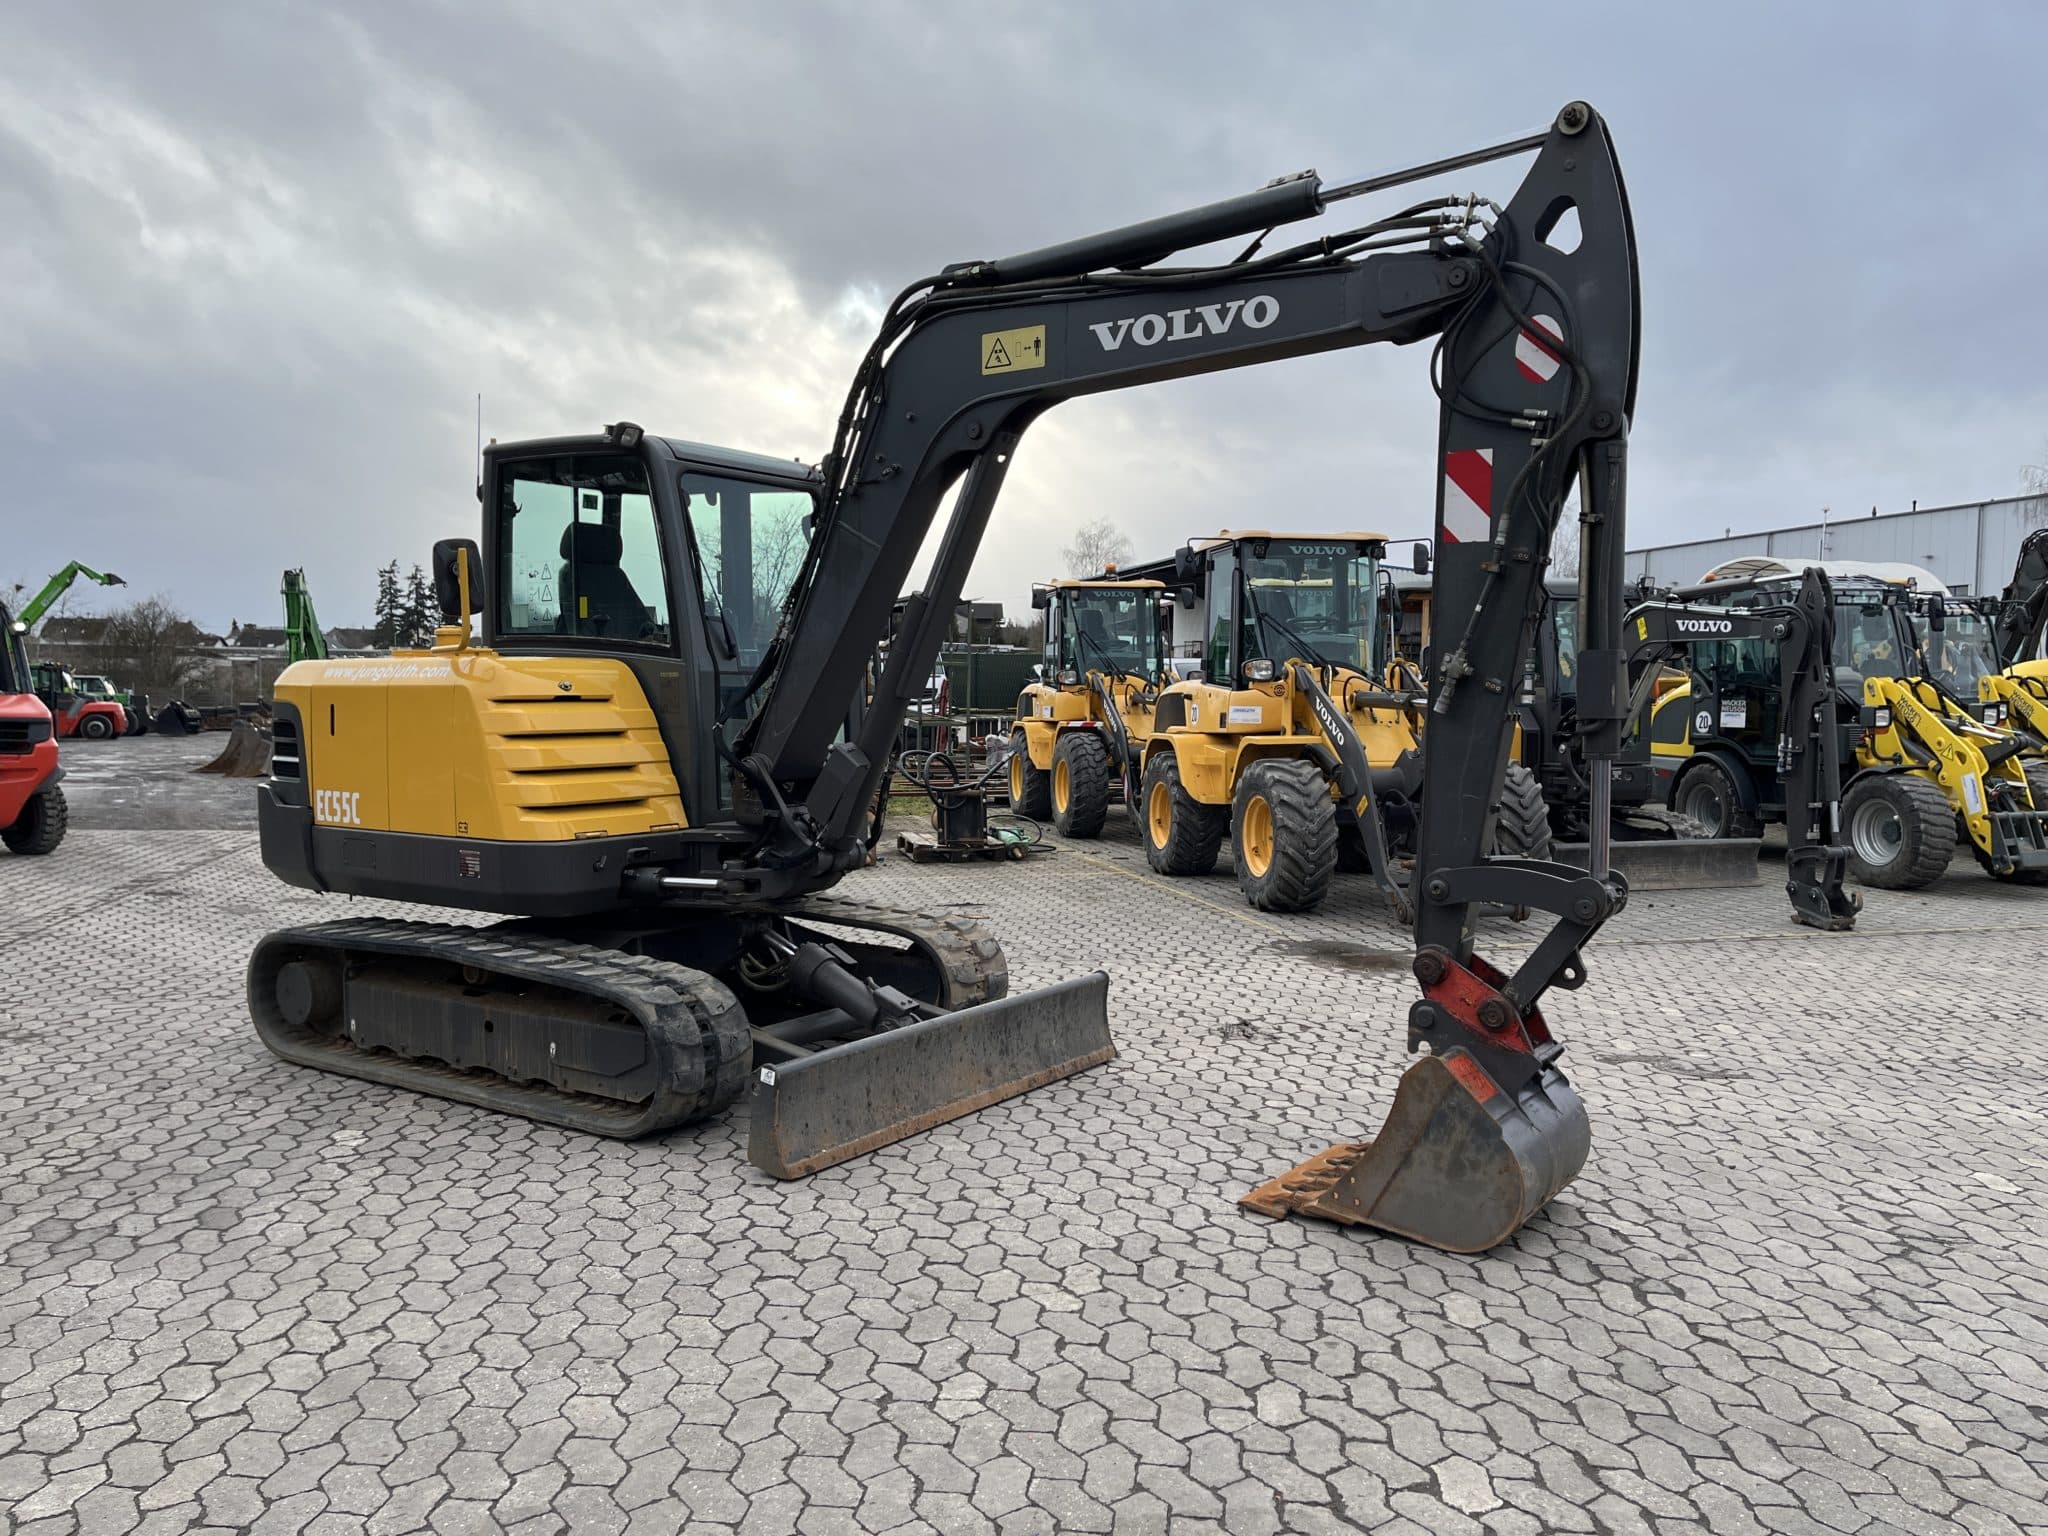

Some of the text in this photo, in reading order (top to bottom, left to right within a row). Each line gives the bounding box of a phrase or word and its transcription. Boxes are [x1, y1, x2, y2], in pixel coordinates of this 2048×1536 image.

[1089, 295, 1280, 351] VOLVO
[1288, 546, 1347, 555] VOLVO
[1676, 620, 1732, 633] VOLVO
[324, 664, 450, 680] www.jungbluth.com
[1315, 696, 1345, 746] VOLVO
[1699, 715, 1709, 729] 20
[316, 790, 361, 824] EC55C
